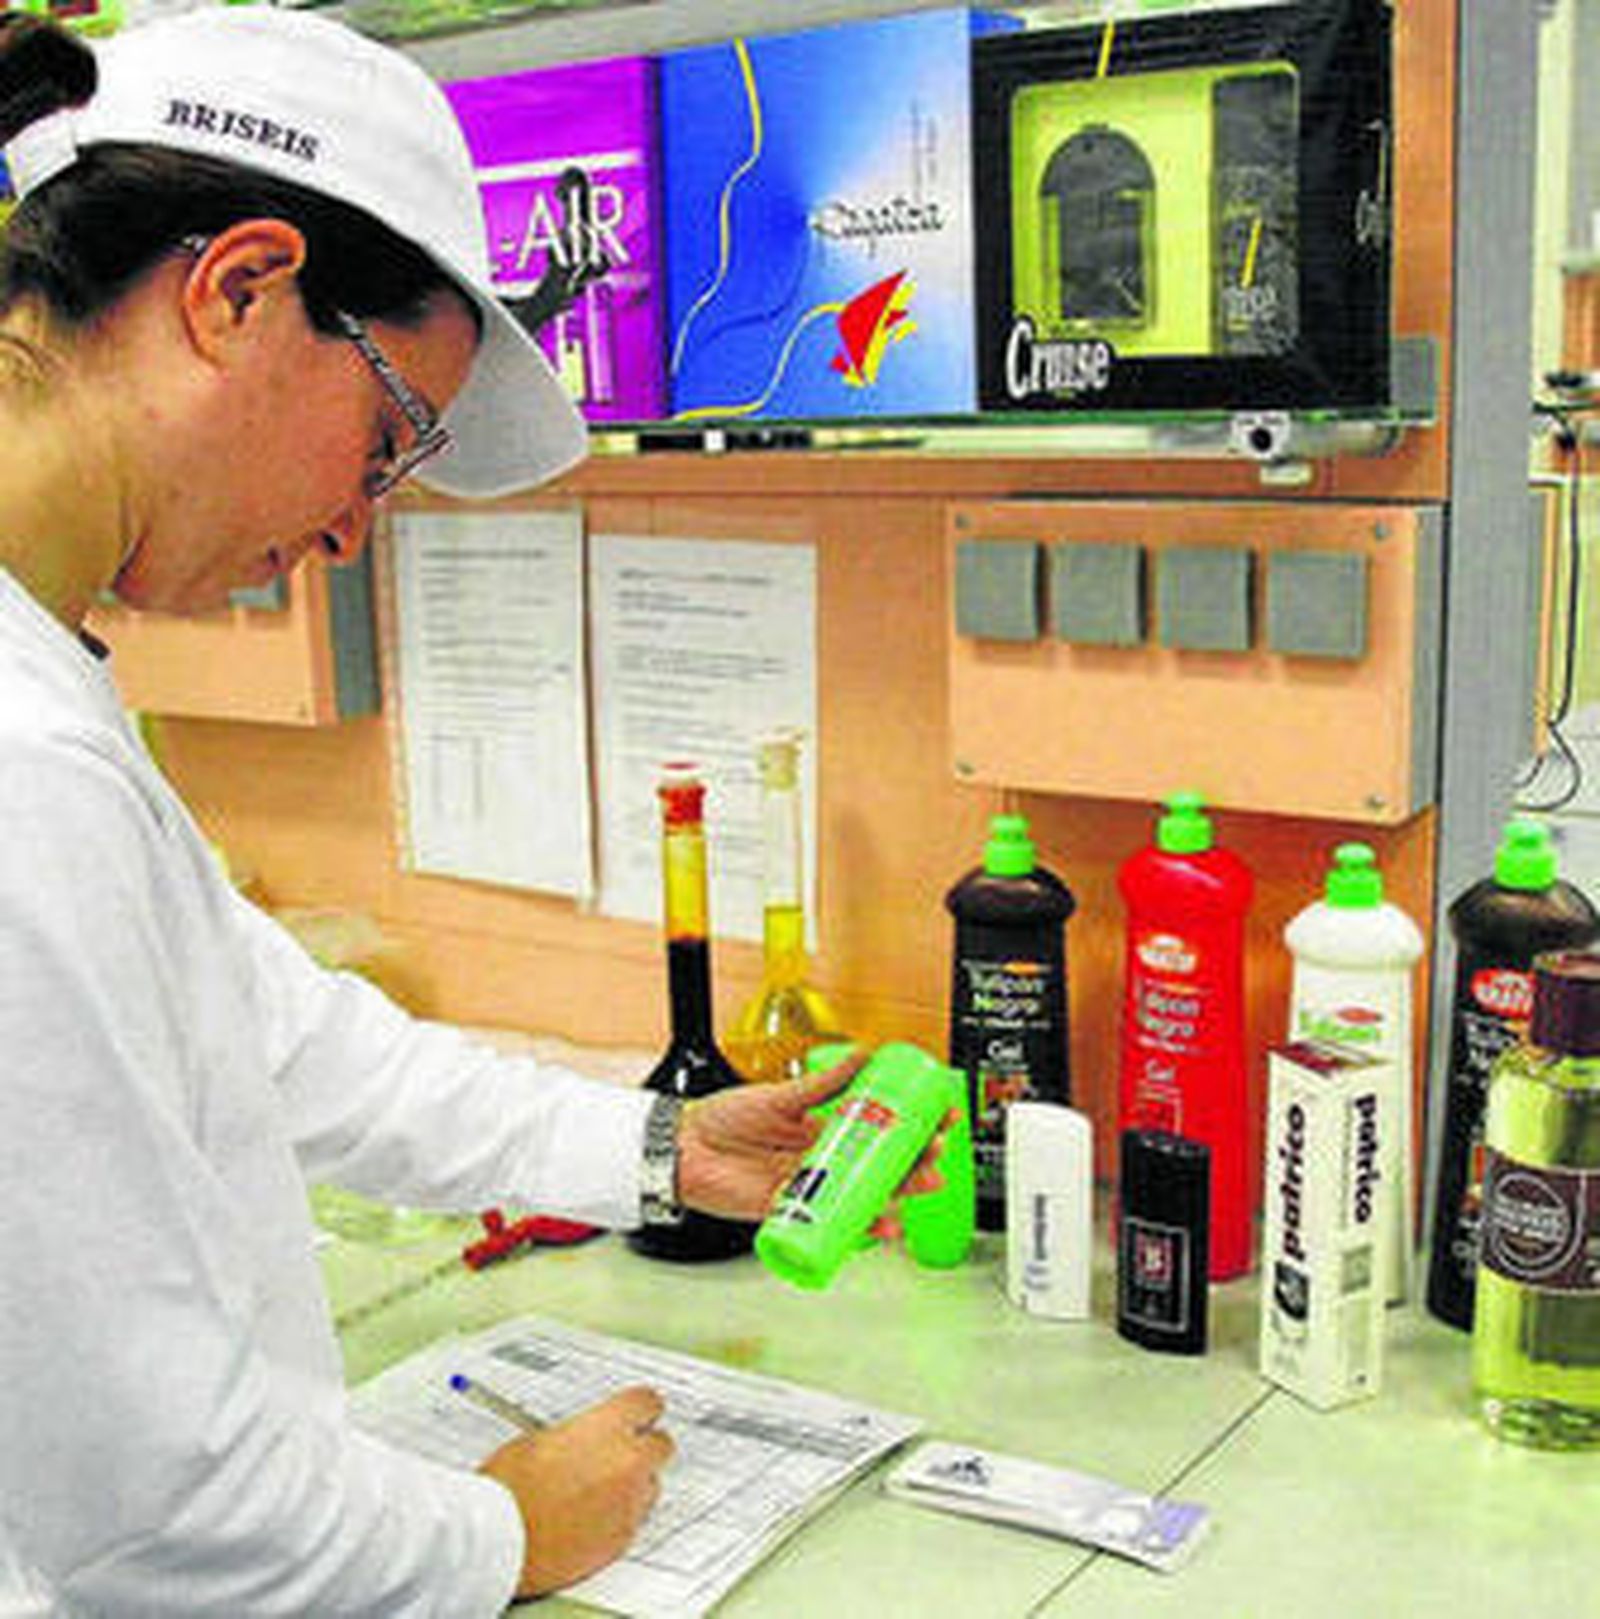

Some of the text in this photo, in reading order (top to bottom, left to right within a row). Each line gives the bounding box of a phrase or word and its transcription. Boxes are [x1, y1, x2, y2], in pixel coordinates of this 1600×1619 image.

[164, 99, 320, 162] BRISEIS
[973, 992, 1041, 1019] Negro
[1277, 1102, 1306, 1263] patrico
[1354, 1093, 1383, 1224] patrico
